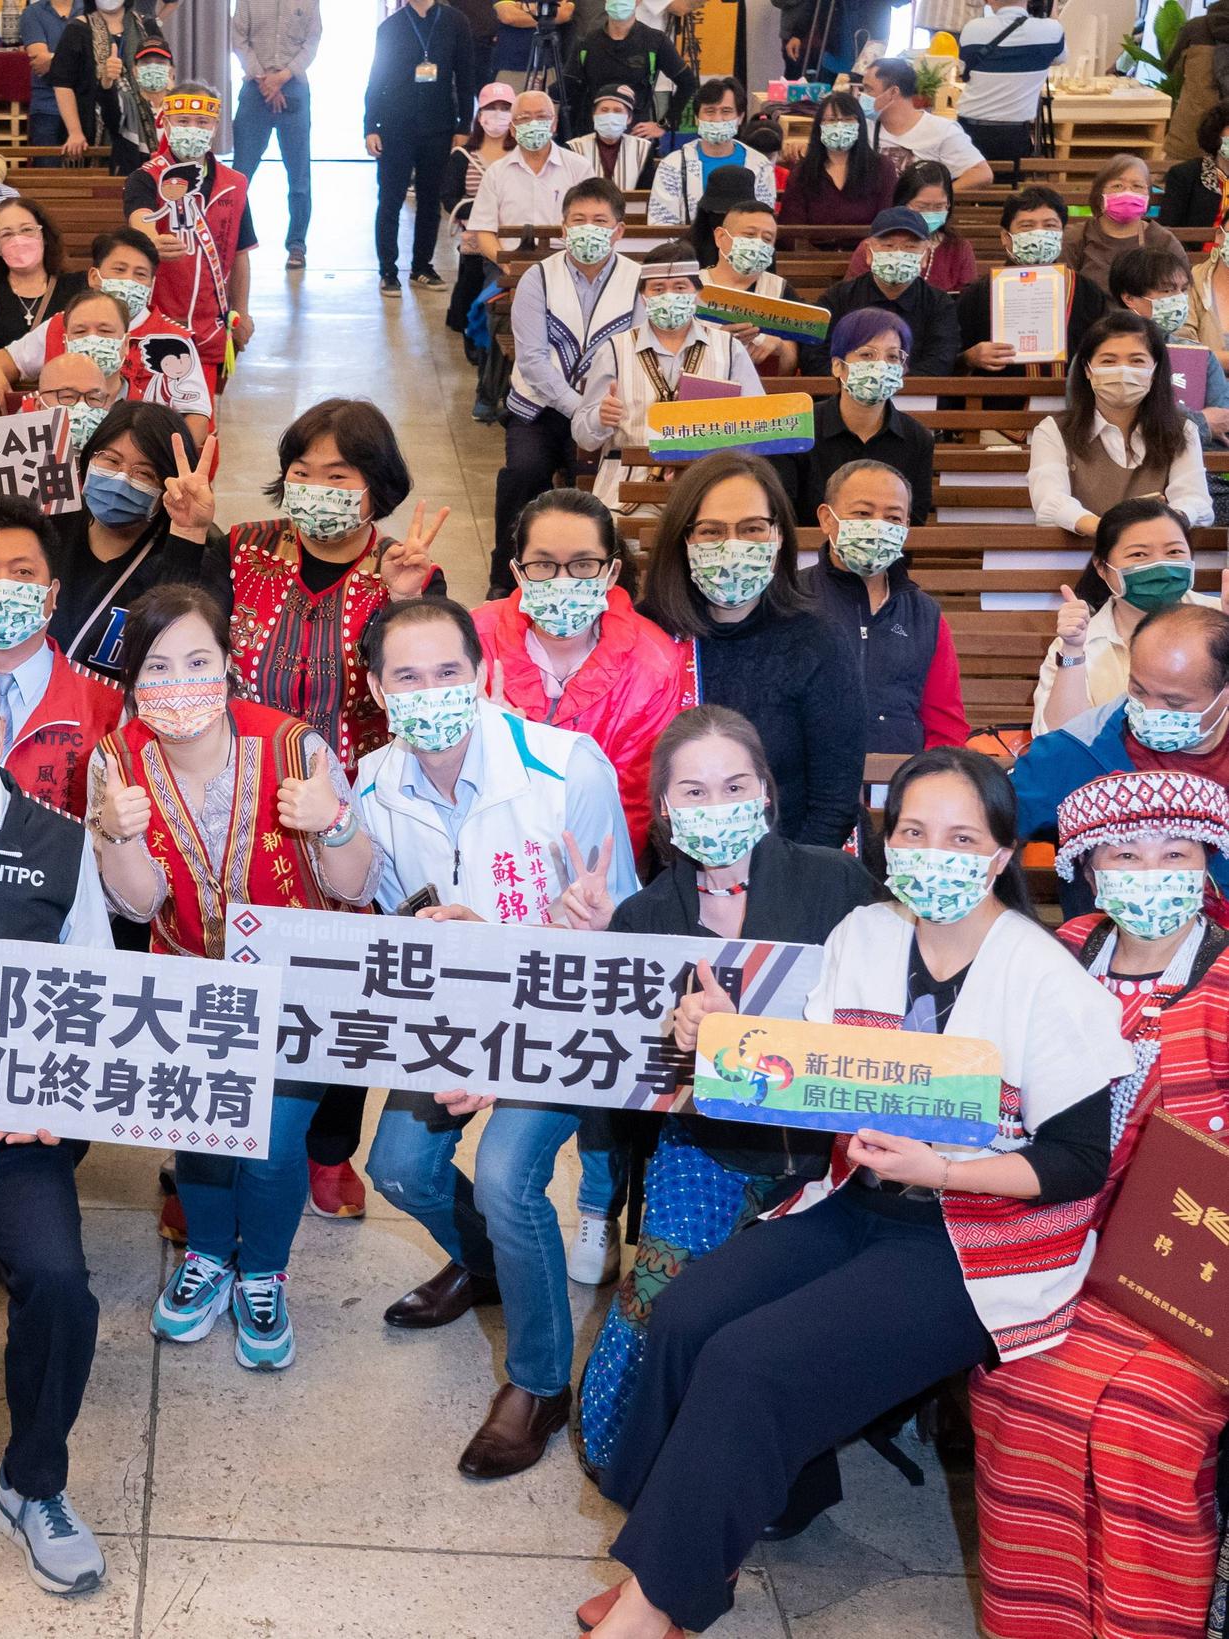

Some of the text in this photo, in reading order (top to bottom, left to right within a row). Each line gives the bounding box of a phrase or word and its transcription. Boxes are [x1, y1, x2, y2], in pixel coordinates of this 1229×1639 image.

[662, 417, 799, 440] 與市民共創共融共學
[34, 731, 84, 748] NTPC
[805, 1052, 933, 1087] 新北市政府
[802, 1084, 983, 1124] 原住民族行政局
